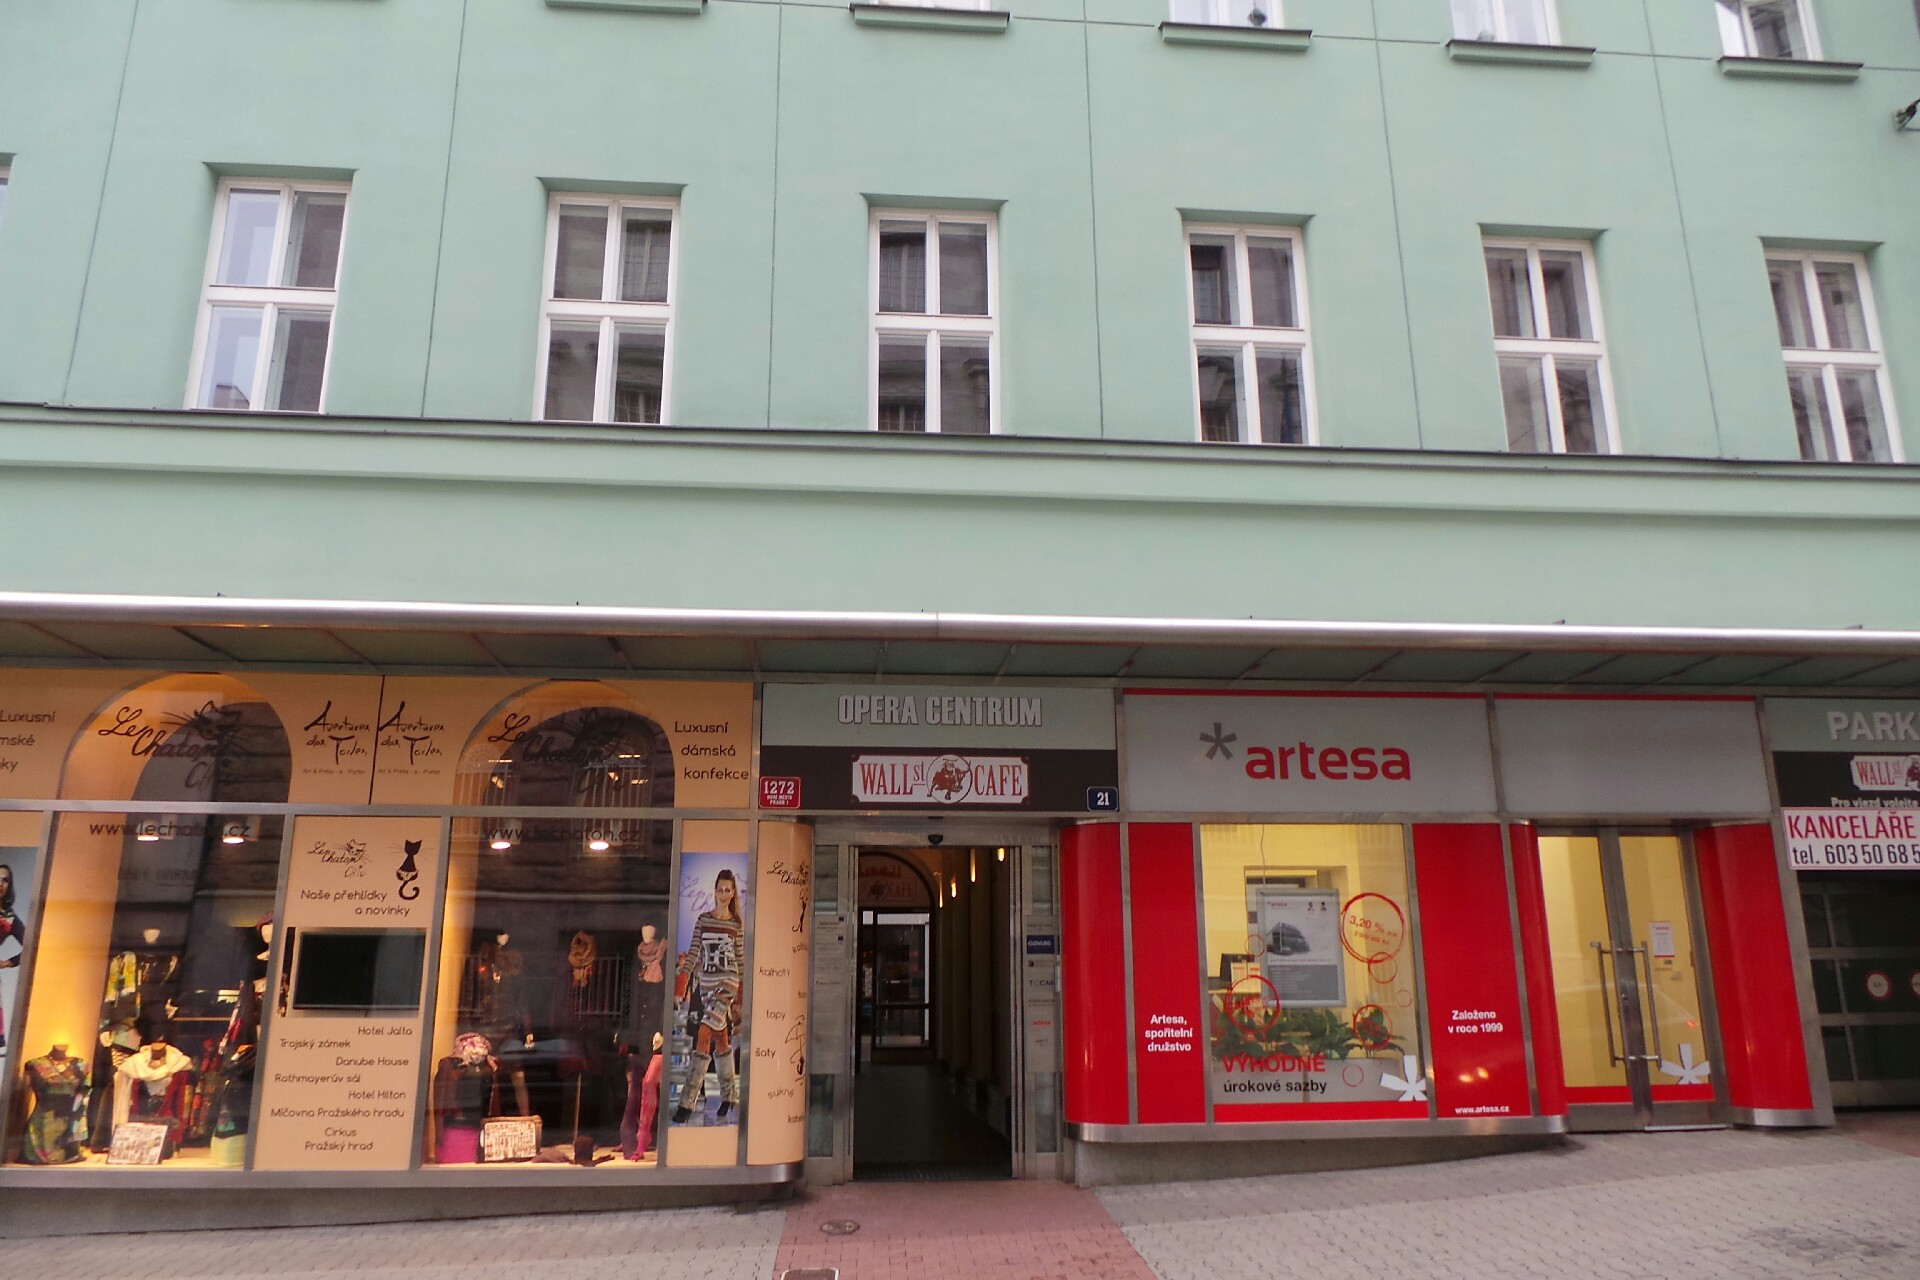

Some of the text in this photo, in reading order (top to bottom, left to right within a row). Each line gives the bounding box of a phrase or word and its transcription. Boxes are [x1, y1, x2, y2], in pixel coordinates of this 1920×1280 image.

[0, 709, 56, 723] Luxusní
[838, 694, 1043, 727] OPERA CENTRUM
[674, 721, 729, 734] Luxusní
[1826, 711, 1920, 741] PARK
[681, 744, 736, 757] dámská
[1245, 741, 1411, 780] artesa
[684, 766, 749, 780] konfekce
[860, 762, 913, 796] WALL
[974, 764, 1023, 796] CAFE
[1856, 761, 1895, 785] WALL
[764, 780, 795, 795] 1272
[1096, 791, 1110, 806] 21
[1788, 811, 1917, 839] KANCELÁŘE
[1792, 844, 1820, 865] tel.
[1824, 844, 1858, 865] 603
[1861, 844, 1883, 865] 50
[1887, 844, 1909, 865] 68
[300, 889, 387, 903] Naše přehlídky
[355, 906, 411, 918] a novinky
[1350, 915, 1372, 930] 3,20
[759, 966, 790, 981] kalhoty
[766, 1010, 786, 1021] topy
[1150, 1014, 1188, 1026] Artesa,
[1451, 1009, 1497, 1021] Založeno
[357, 1026, 413, 1036] Hotel Jalta
[1144, 1027, 1194, 1041] spořitelní
[1447, 1022, 1504, 1034] v roce 1999
[279, 1038, 351, 1050] Trojský zámek
[1147, 1041, 1192, 1052] družstvo
[756, 1048, 777, 1059] šaty
[335, 1057, 410, 1066] Danube House
[1221, 1050, 1327, 1073] VÝHODNÉ
[346, 1073, 361, 1083] sál
[1223, 1079, 1327, 1094] úrokové sazby
[348, 1090, 406, 1100] Hotel Hilton
[271, 1106, 405, 1118] Míčovna Pražského hradu
[1455, 1105, 1510, 1114] www.artesa.cz
[324, 1127, 357, 1137] Cirkus
[304, 1141, 374, 1152] Pražský hrad
